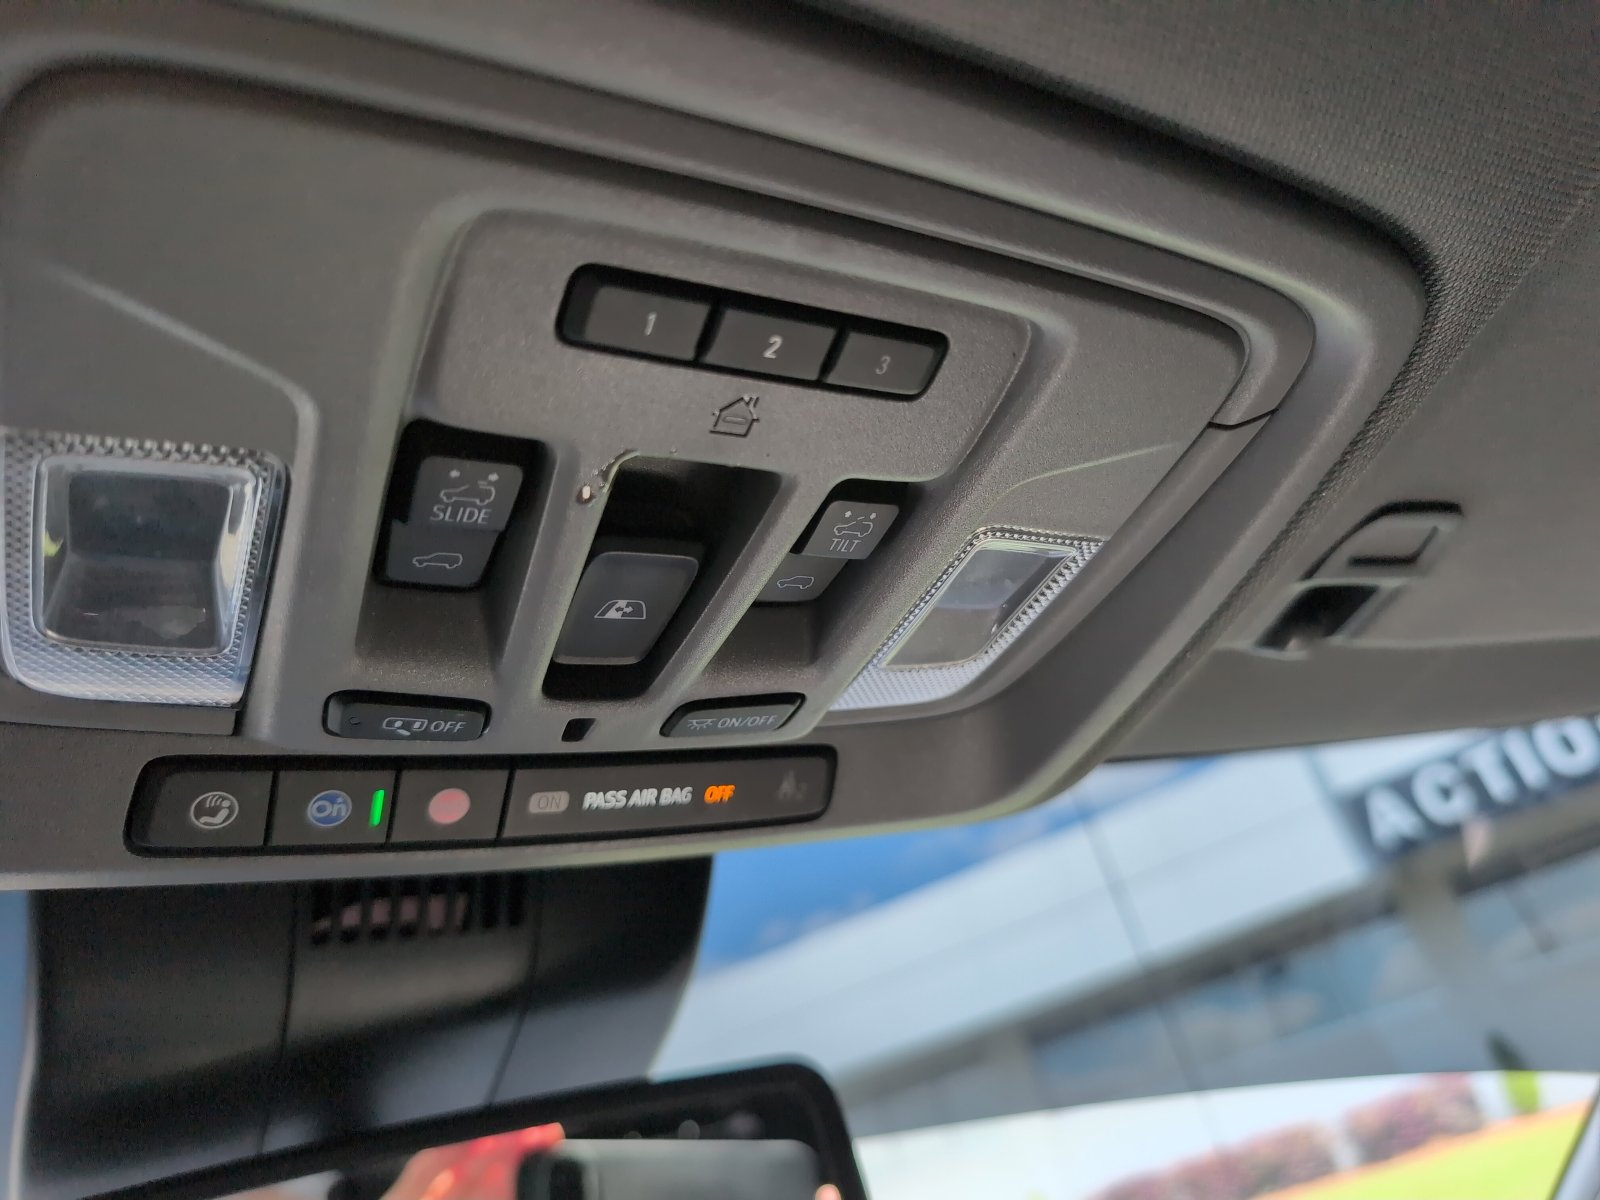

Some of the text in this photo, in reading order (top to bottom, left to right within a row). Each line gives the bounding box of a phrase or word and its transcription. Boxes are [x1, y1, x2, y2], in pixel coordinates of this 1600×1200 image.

[644, 312, 657, 335] 1
[762, 335, 783, 359] 2
[875, 356, 891, 375] 3
[430, 504, 492, 525] SLIDE
[829, 538, 862, 553] TILT
[430, 719, 467, 734] OFF
[717, 714, 778, 729] ON/OFF
[1364, 715, 1600, 849] ACTIO
[537, 784, 735, 811] ON PASS AIR BAG OFF
